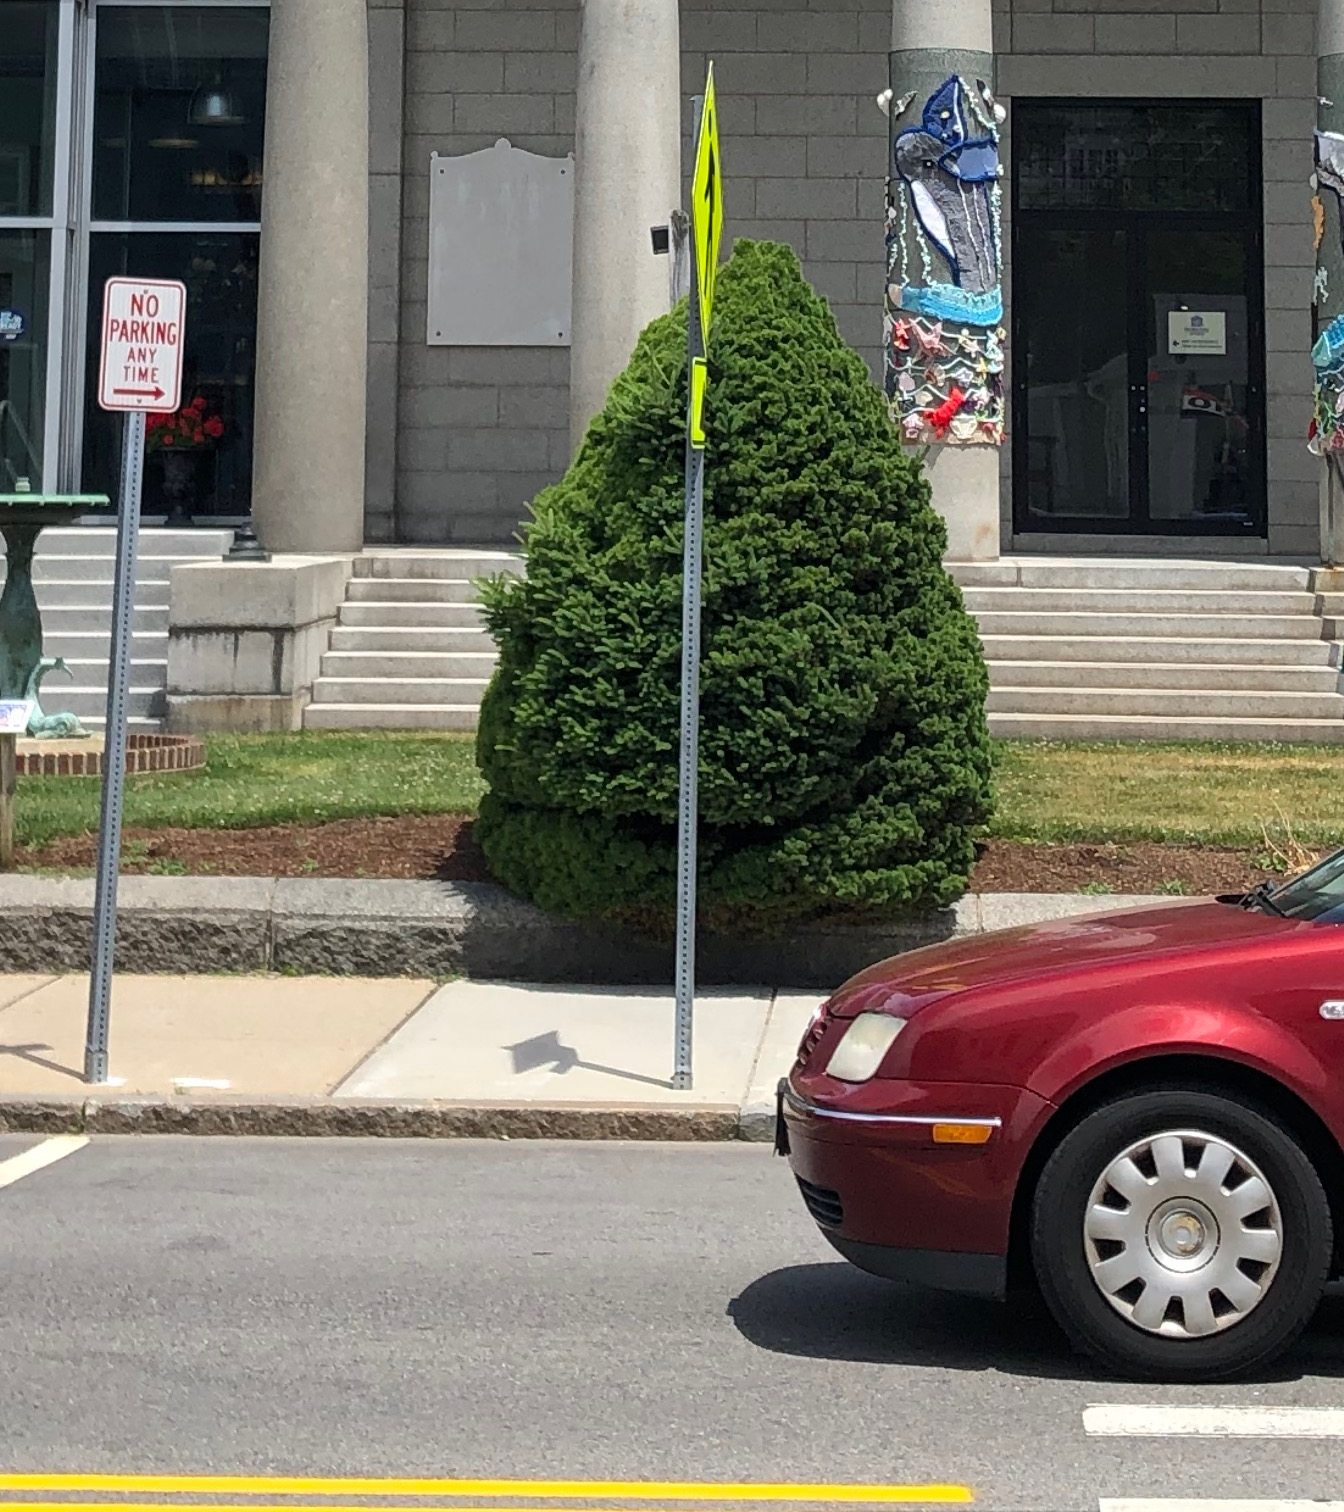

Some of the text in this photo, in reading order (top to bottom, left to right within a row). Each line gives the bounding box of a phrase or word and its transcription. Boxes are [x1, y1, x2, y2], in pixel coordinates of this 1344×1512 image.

[131, 294, 159, 317] NO
[109, 319, 177, 346] PARKING
[127, 347, 157, 363] ANY
[123, 366, 160, 384] TIME
